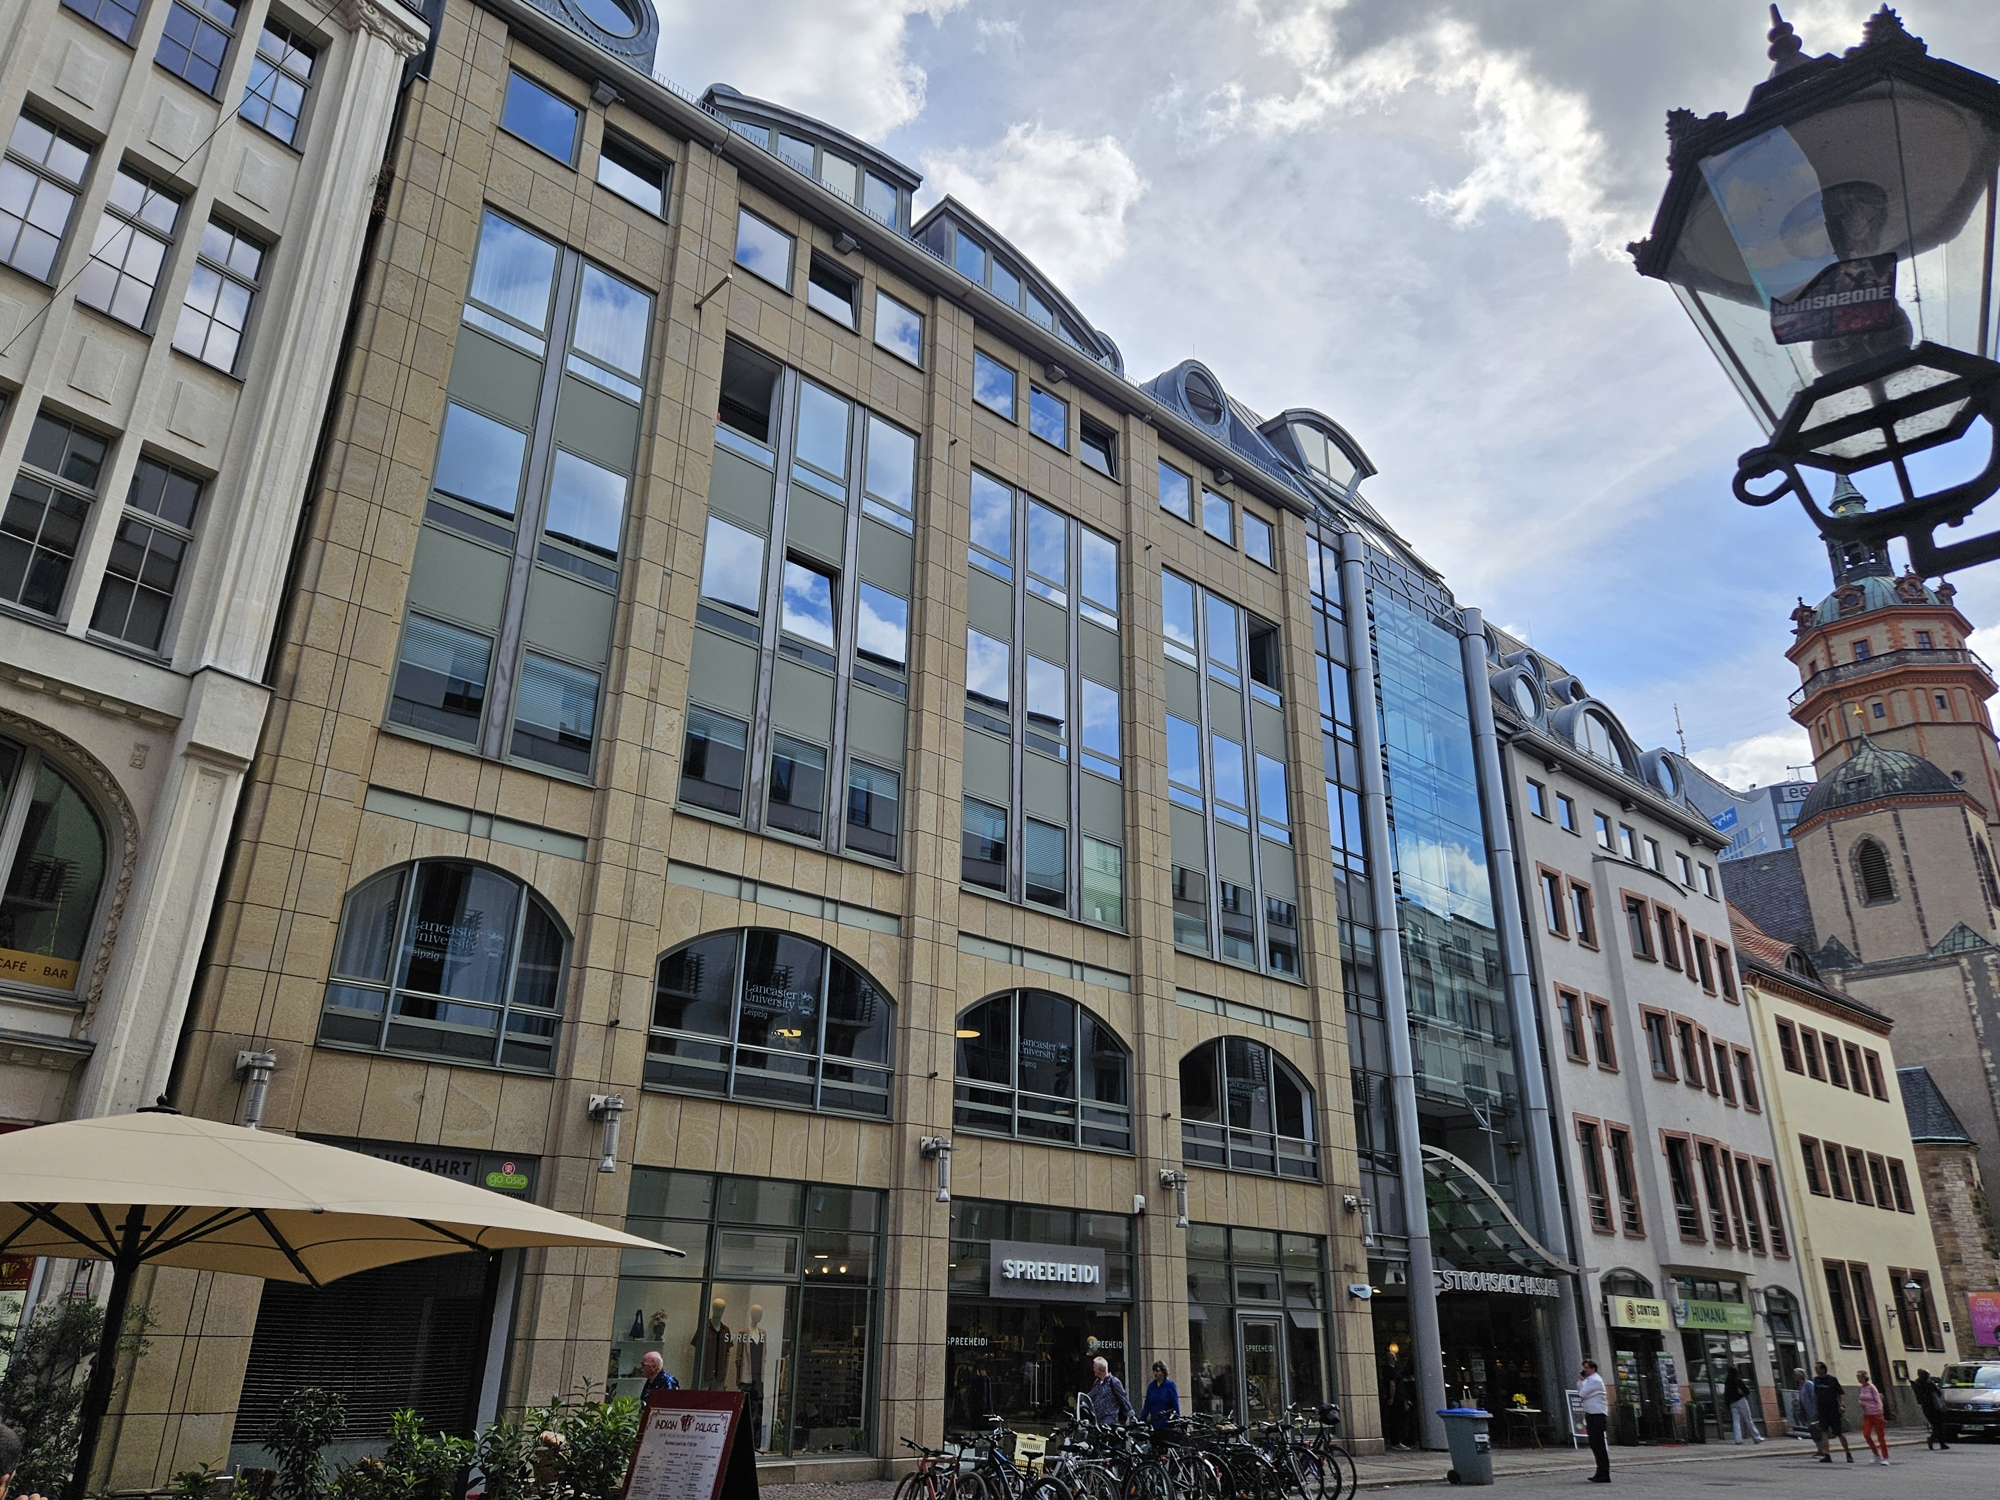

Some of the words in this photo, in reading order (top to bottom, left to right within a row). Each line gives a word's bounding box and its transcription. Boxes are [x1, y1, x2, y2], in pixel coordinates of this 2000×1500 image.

[1789, 784, 1814, 799] ee
[411, 948, 440, 962] eipzig
[43, 966, 68, 979] BAR
[745, 980, 798, 1000] Lancaster
[744, 991, 796, 1012] University
[743, 1006, 768, 1019] Leipzig
[1018, 1035, 1057, 1051] Lancaster
[1018, 1044, 1056, 1061] University
[489, 1174, 504, 1186] go
[505, 1174, 526, 1186] asia
[1002, 1259, 1099, 1284] SPREEHEIDI
[1636, 1304, 1660, 1317] CONTIGO
[1690, 1305, 1728, 1324] HUMANA
[655, 1420, 678, 1432] INDIAN
[694, 1423, 721, 1434] PALACE
